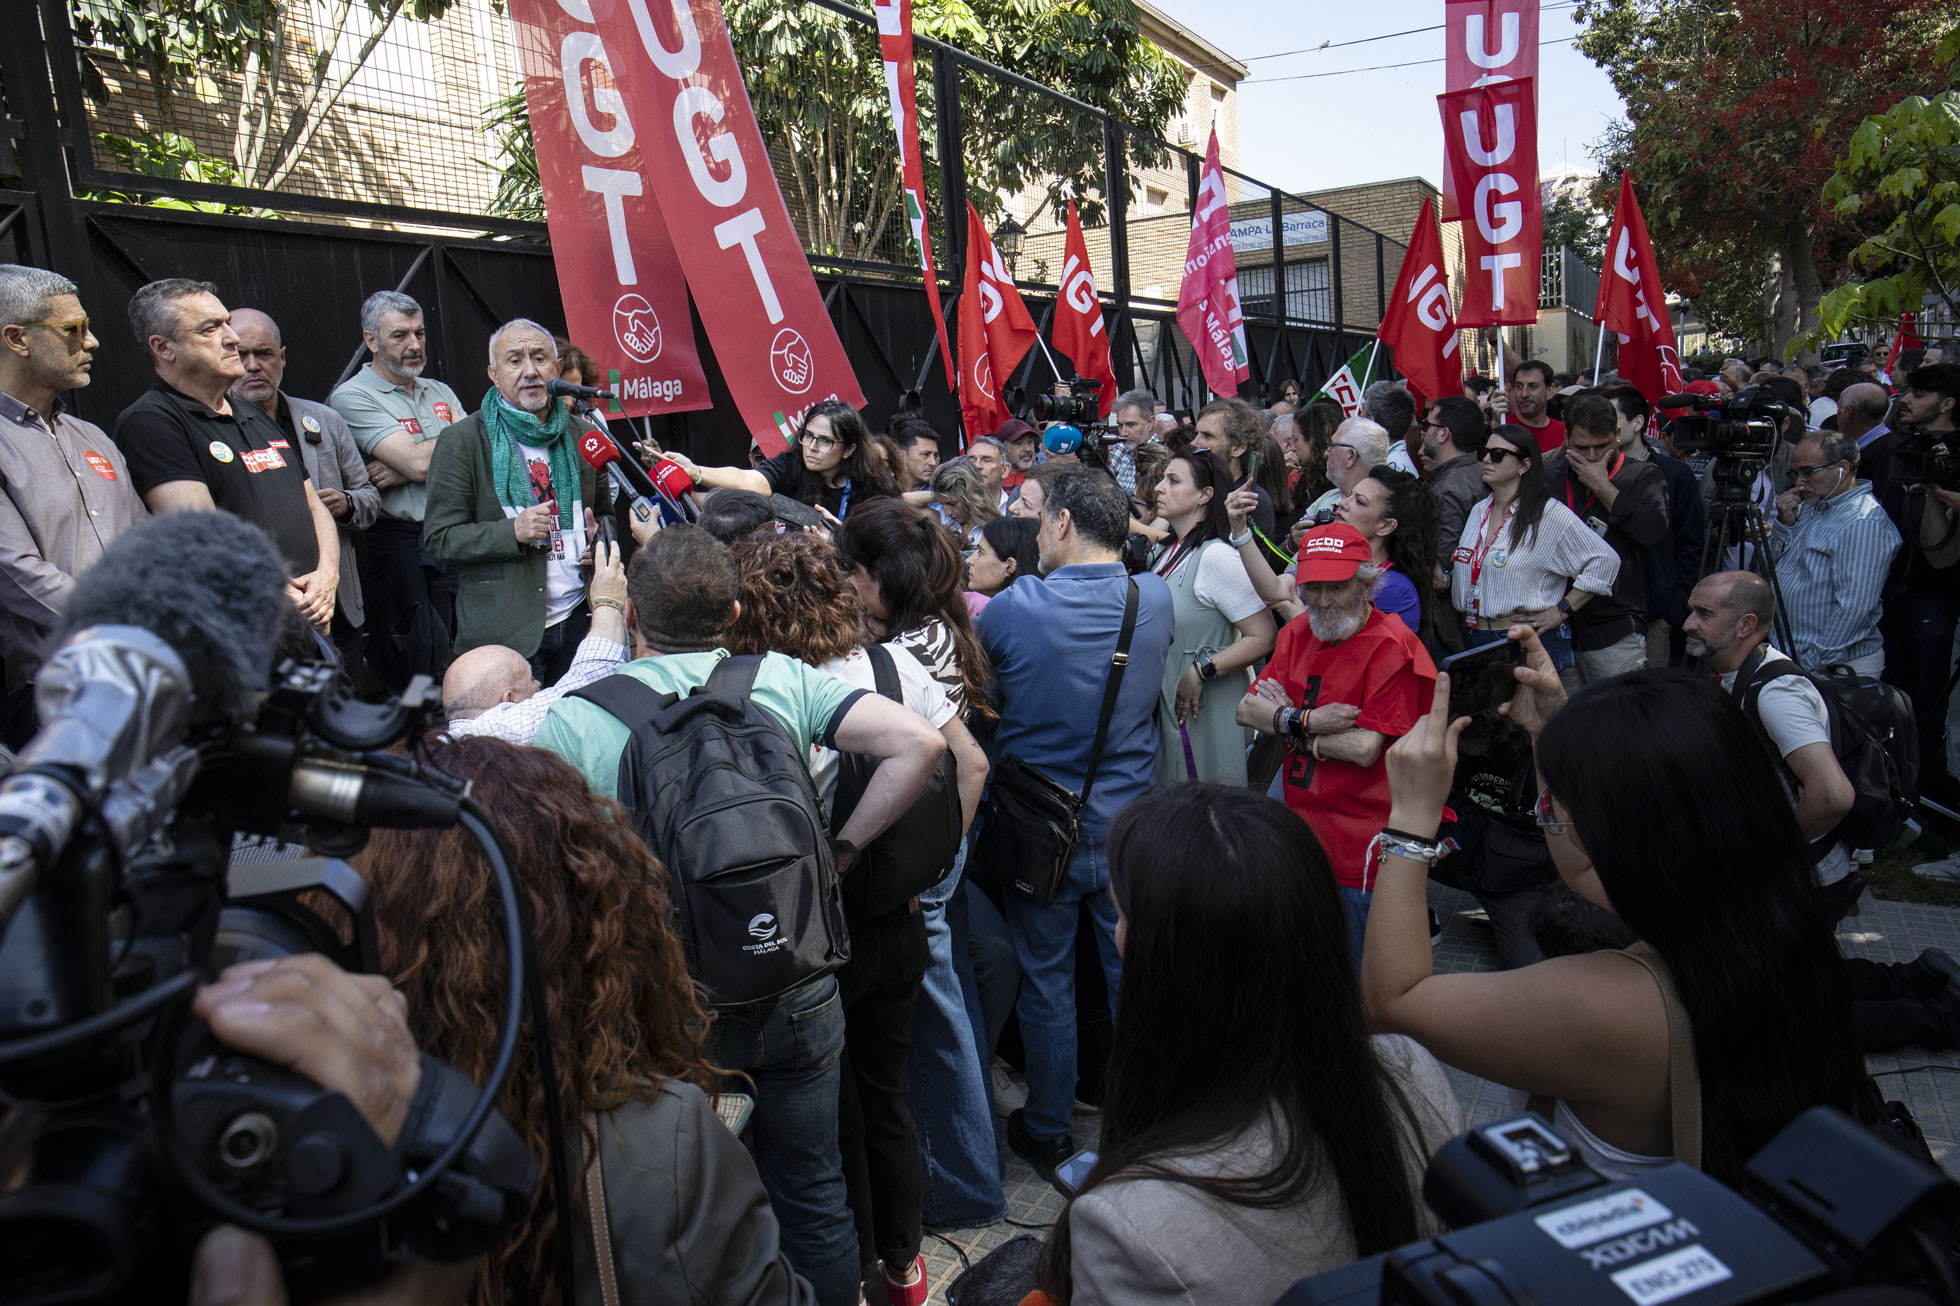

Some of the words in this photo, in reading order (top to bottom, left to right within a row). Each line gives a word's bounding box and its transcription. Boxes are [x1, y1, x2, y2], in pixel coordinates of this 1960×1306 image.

[556, 0, 643, 286] GT
[1282, 219, 1325, 232] Barraca
[1460, 103, 1522, 311] UGT
[1205, 311, 1236, 376] Málag
[623, 376, 683, 402] Málaga
[1307, 536, 1344, 548] CCOO
